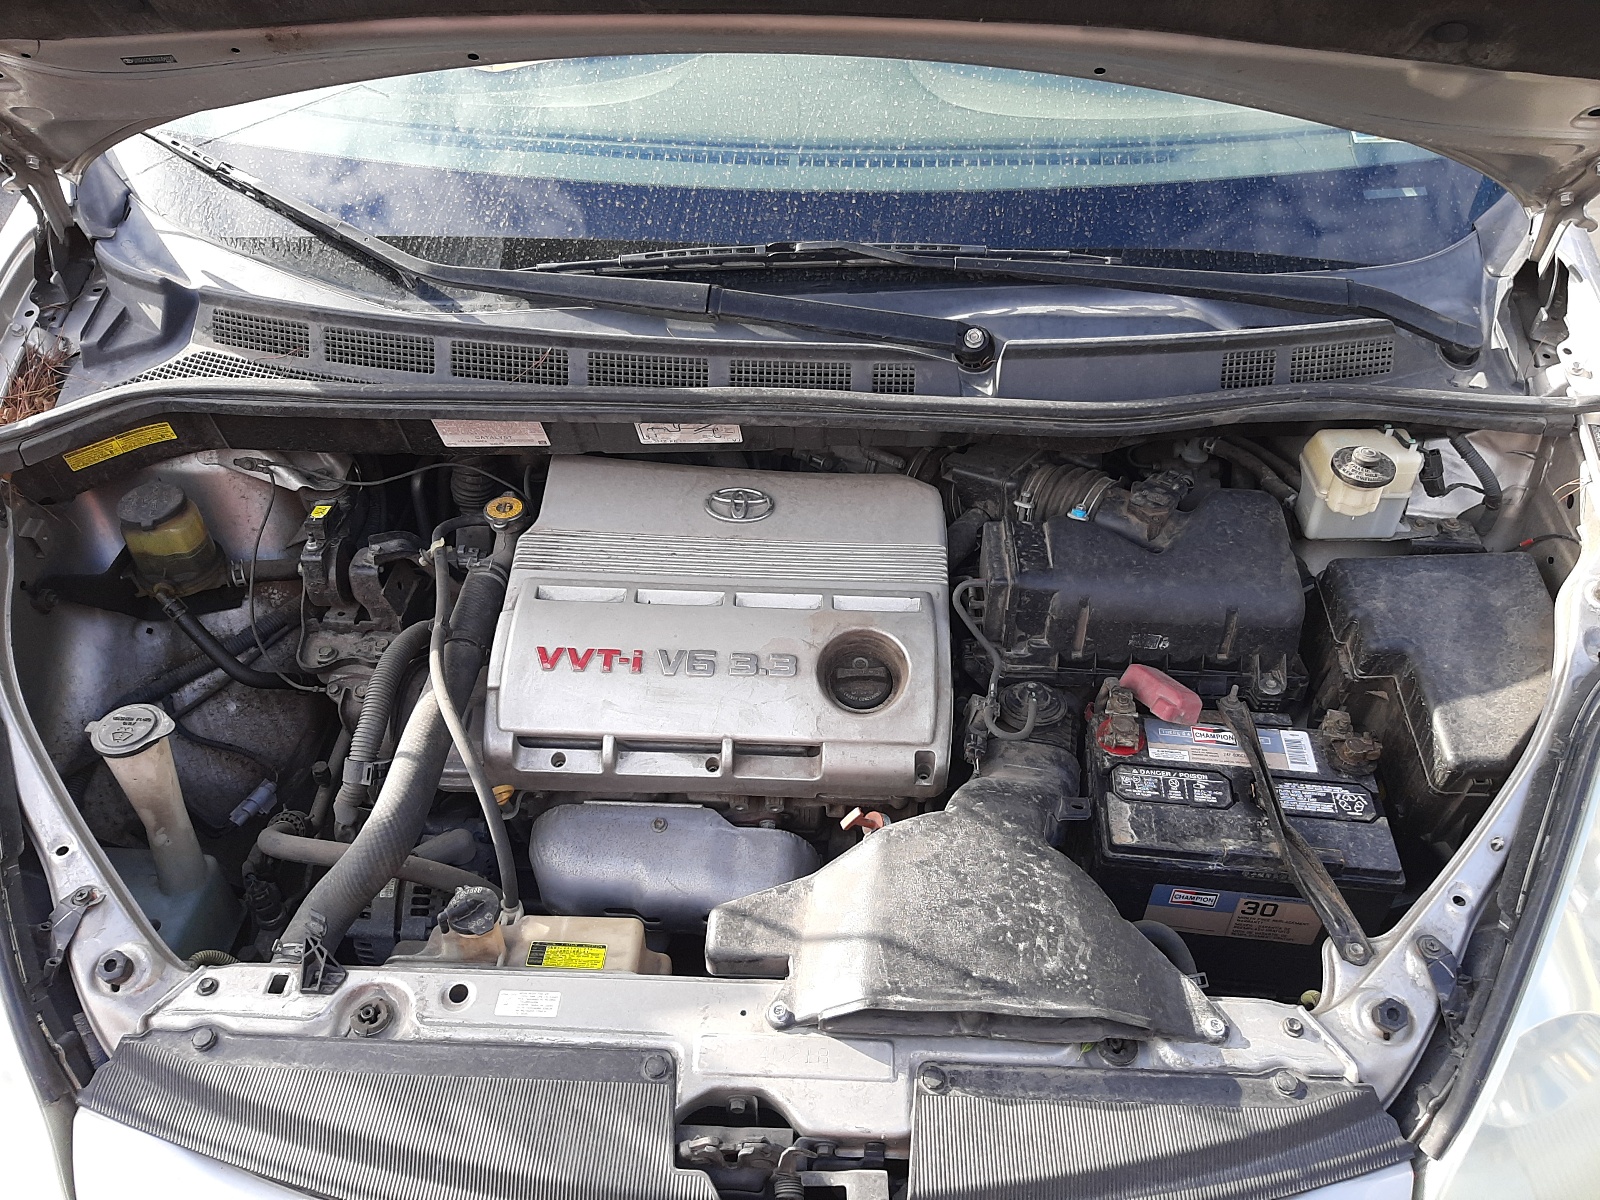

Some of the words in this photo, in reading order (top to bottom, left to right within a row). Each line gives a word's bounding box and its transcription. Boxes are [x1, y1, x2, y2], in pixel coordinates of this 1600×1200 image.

[536, 646, 643, 674] VVT-i
[657, 650, 716, 677] V6
[728, 652, 798, 678] 3.3
[1194, 731, 1236, 741] CHAMPION
[1140, 768, 1172, 777] DANGER
[1179, 772, 1208, 780] POISON
[1173, 893, 1215, 904] CHAMPION
[1240, 901, 1279, 917] 30
